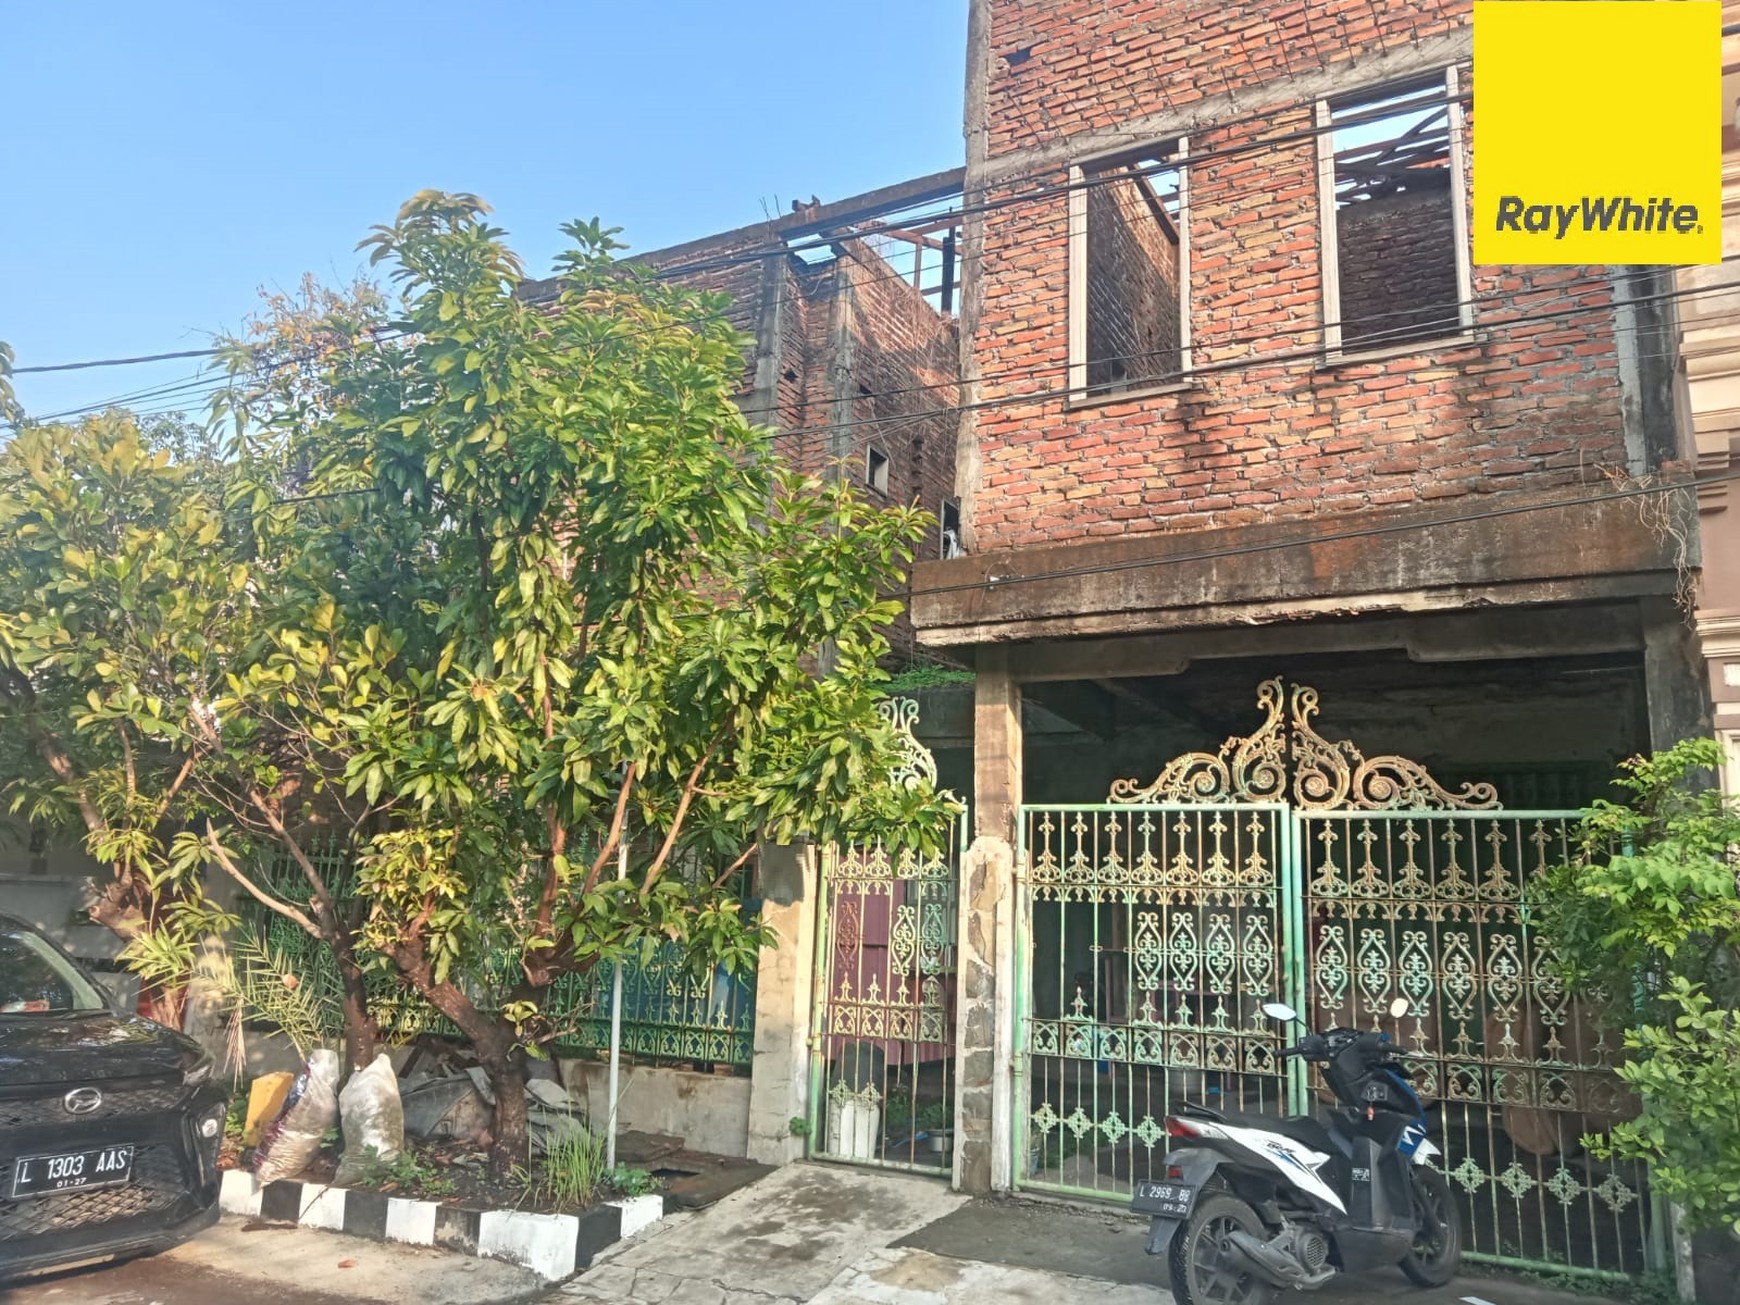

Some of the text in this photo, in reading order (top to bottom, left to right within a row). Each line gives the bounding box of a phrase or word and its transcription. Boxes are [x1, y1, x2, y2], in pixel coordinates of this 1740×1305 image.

[20, 1149, 127, 1183] L 1303 AAS
[56, 1177, 88, 1188] 01-27
[1139, 1185, 1145, 1197] L
